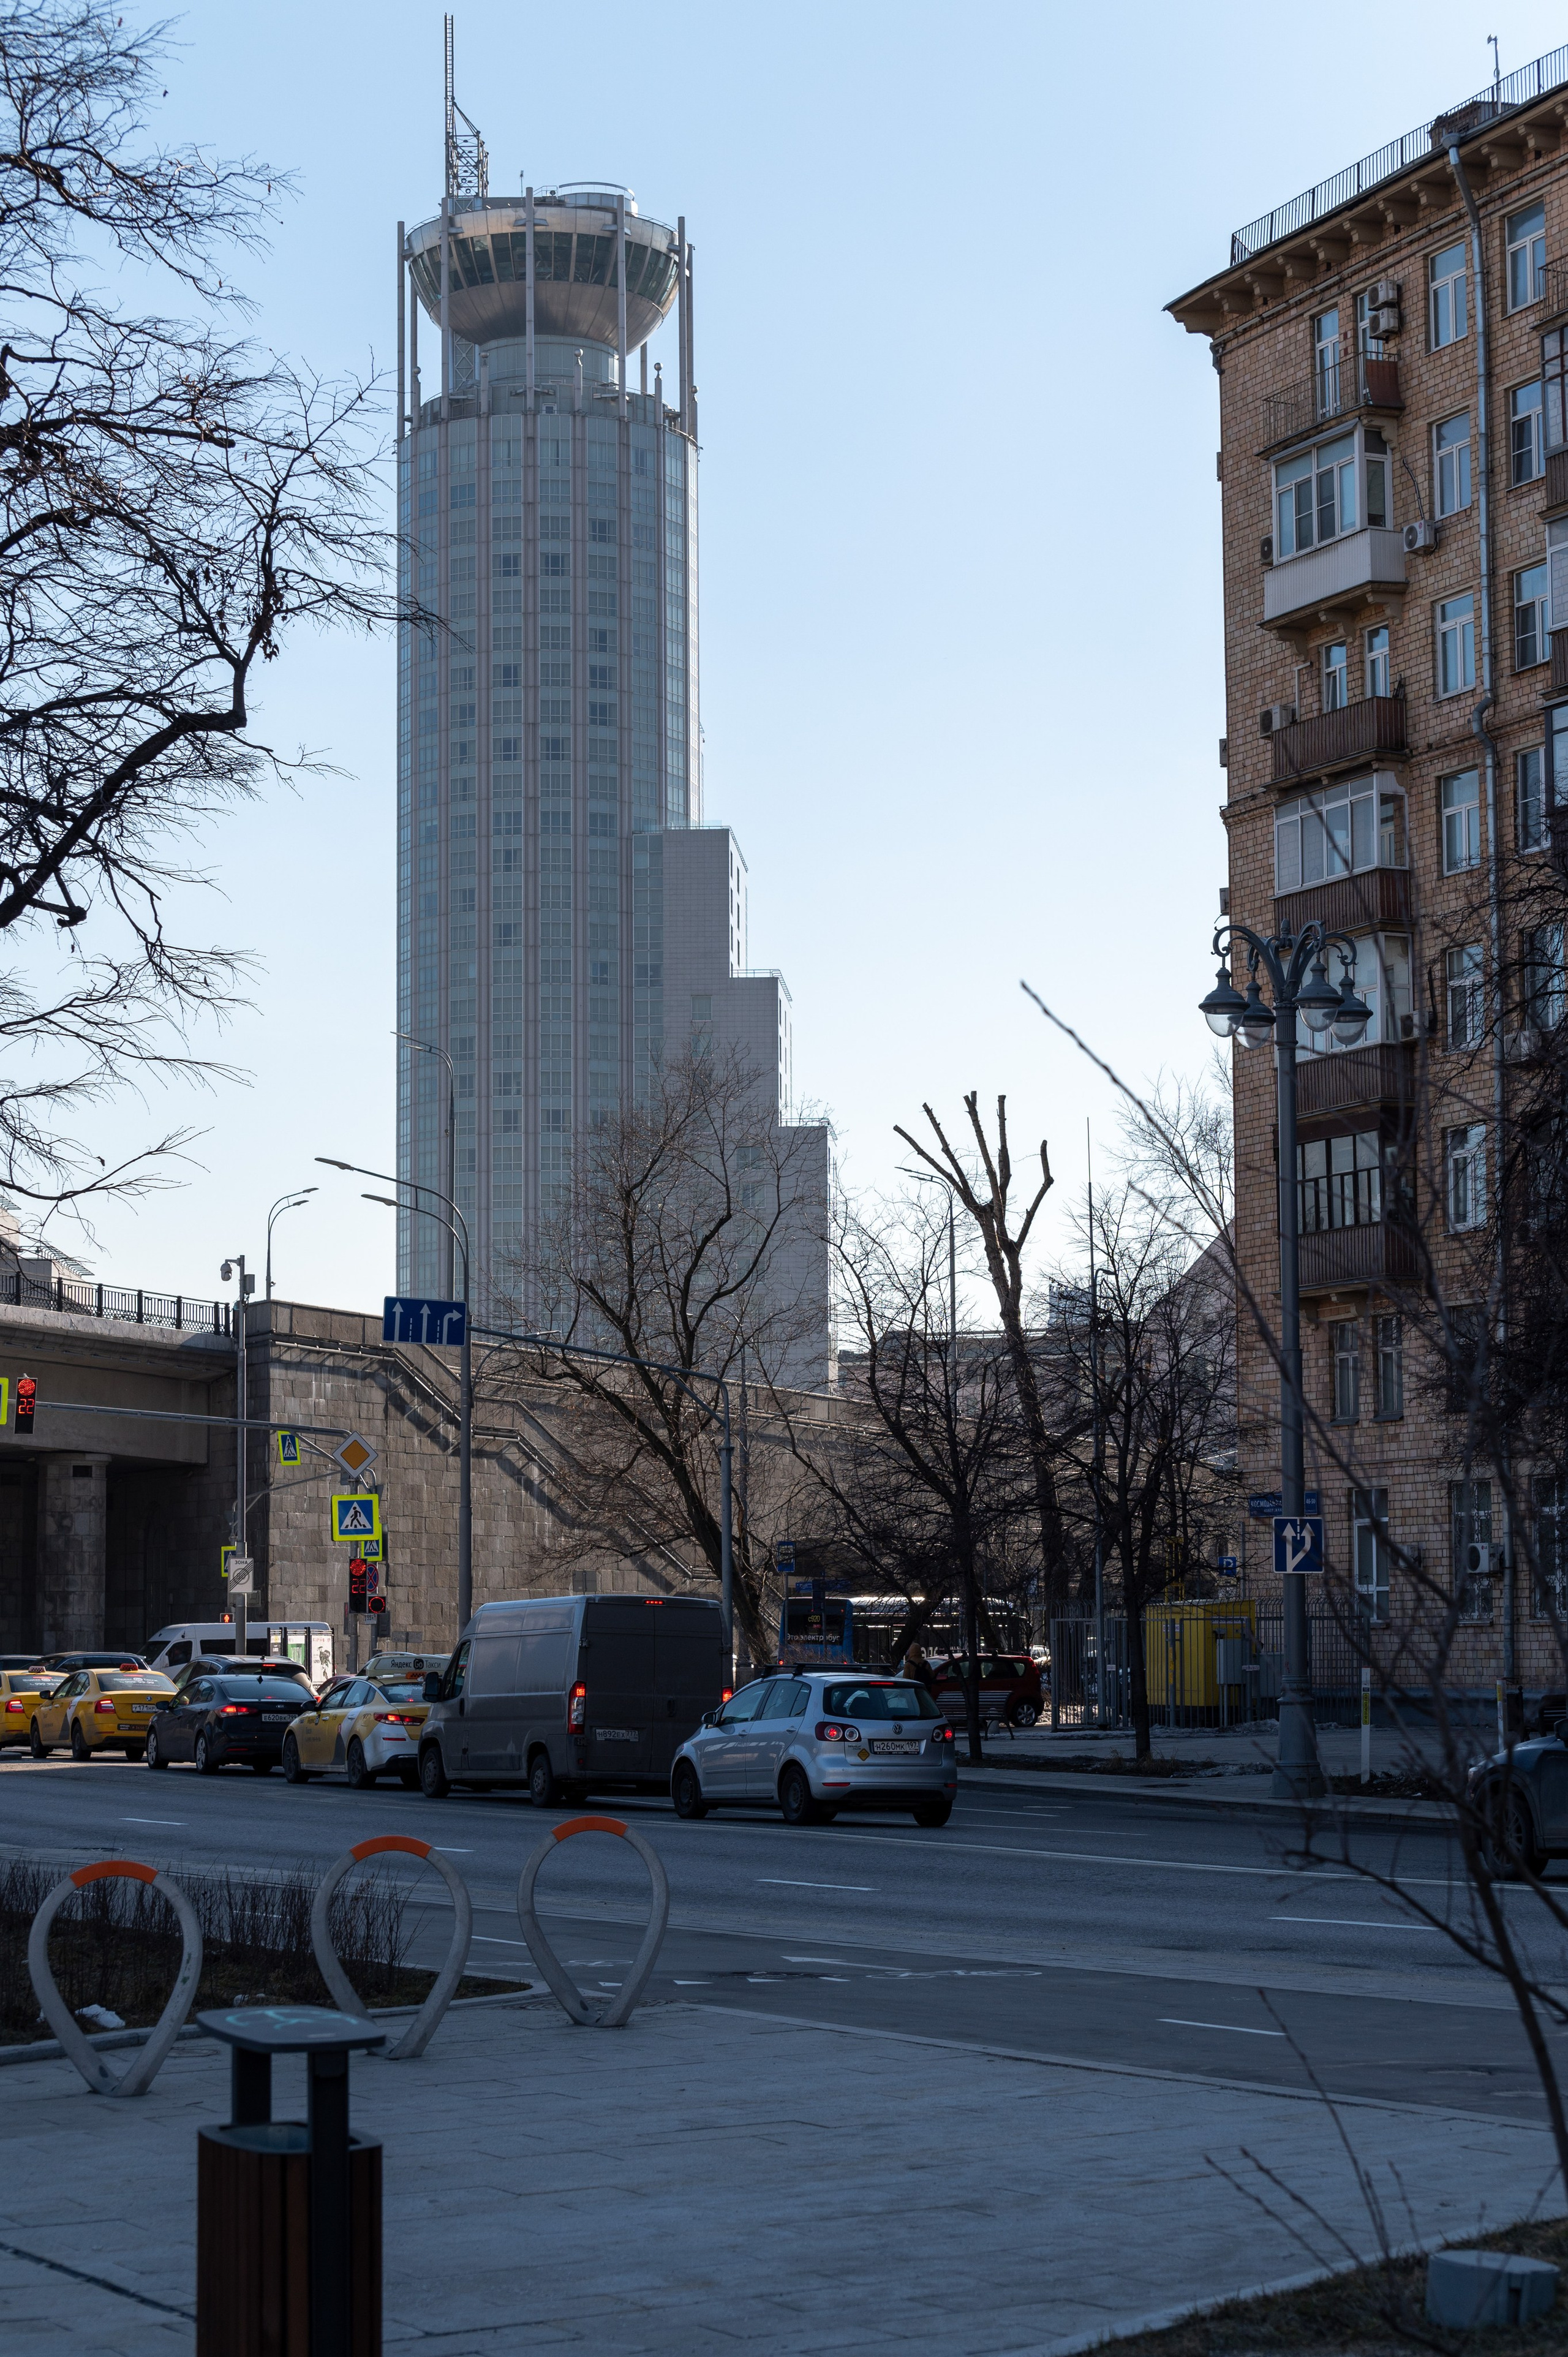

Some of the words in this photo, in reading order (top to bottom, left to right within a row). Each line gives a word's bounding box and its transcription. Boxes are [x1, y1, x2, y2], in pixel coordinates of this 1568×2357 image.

[18, 1398, 34, 1414] 22
[352, 1578, 366, 1594] 22
[800, 1634, 840, 1642] электрбус
[391, 1659, 412, 1669] Яндекс
[414, 1659, 424, 1669] Go
[425, 1660, 441, 1669] Такси
[876, 1742, 905, 1751] Н260МК
